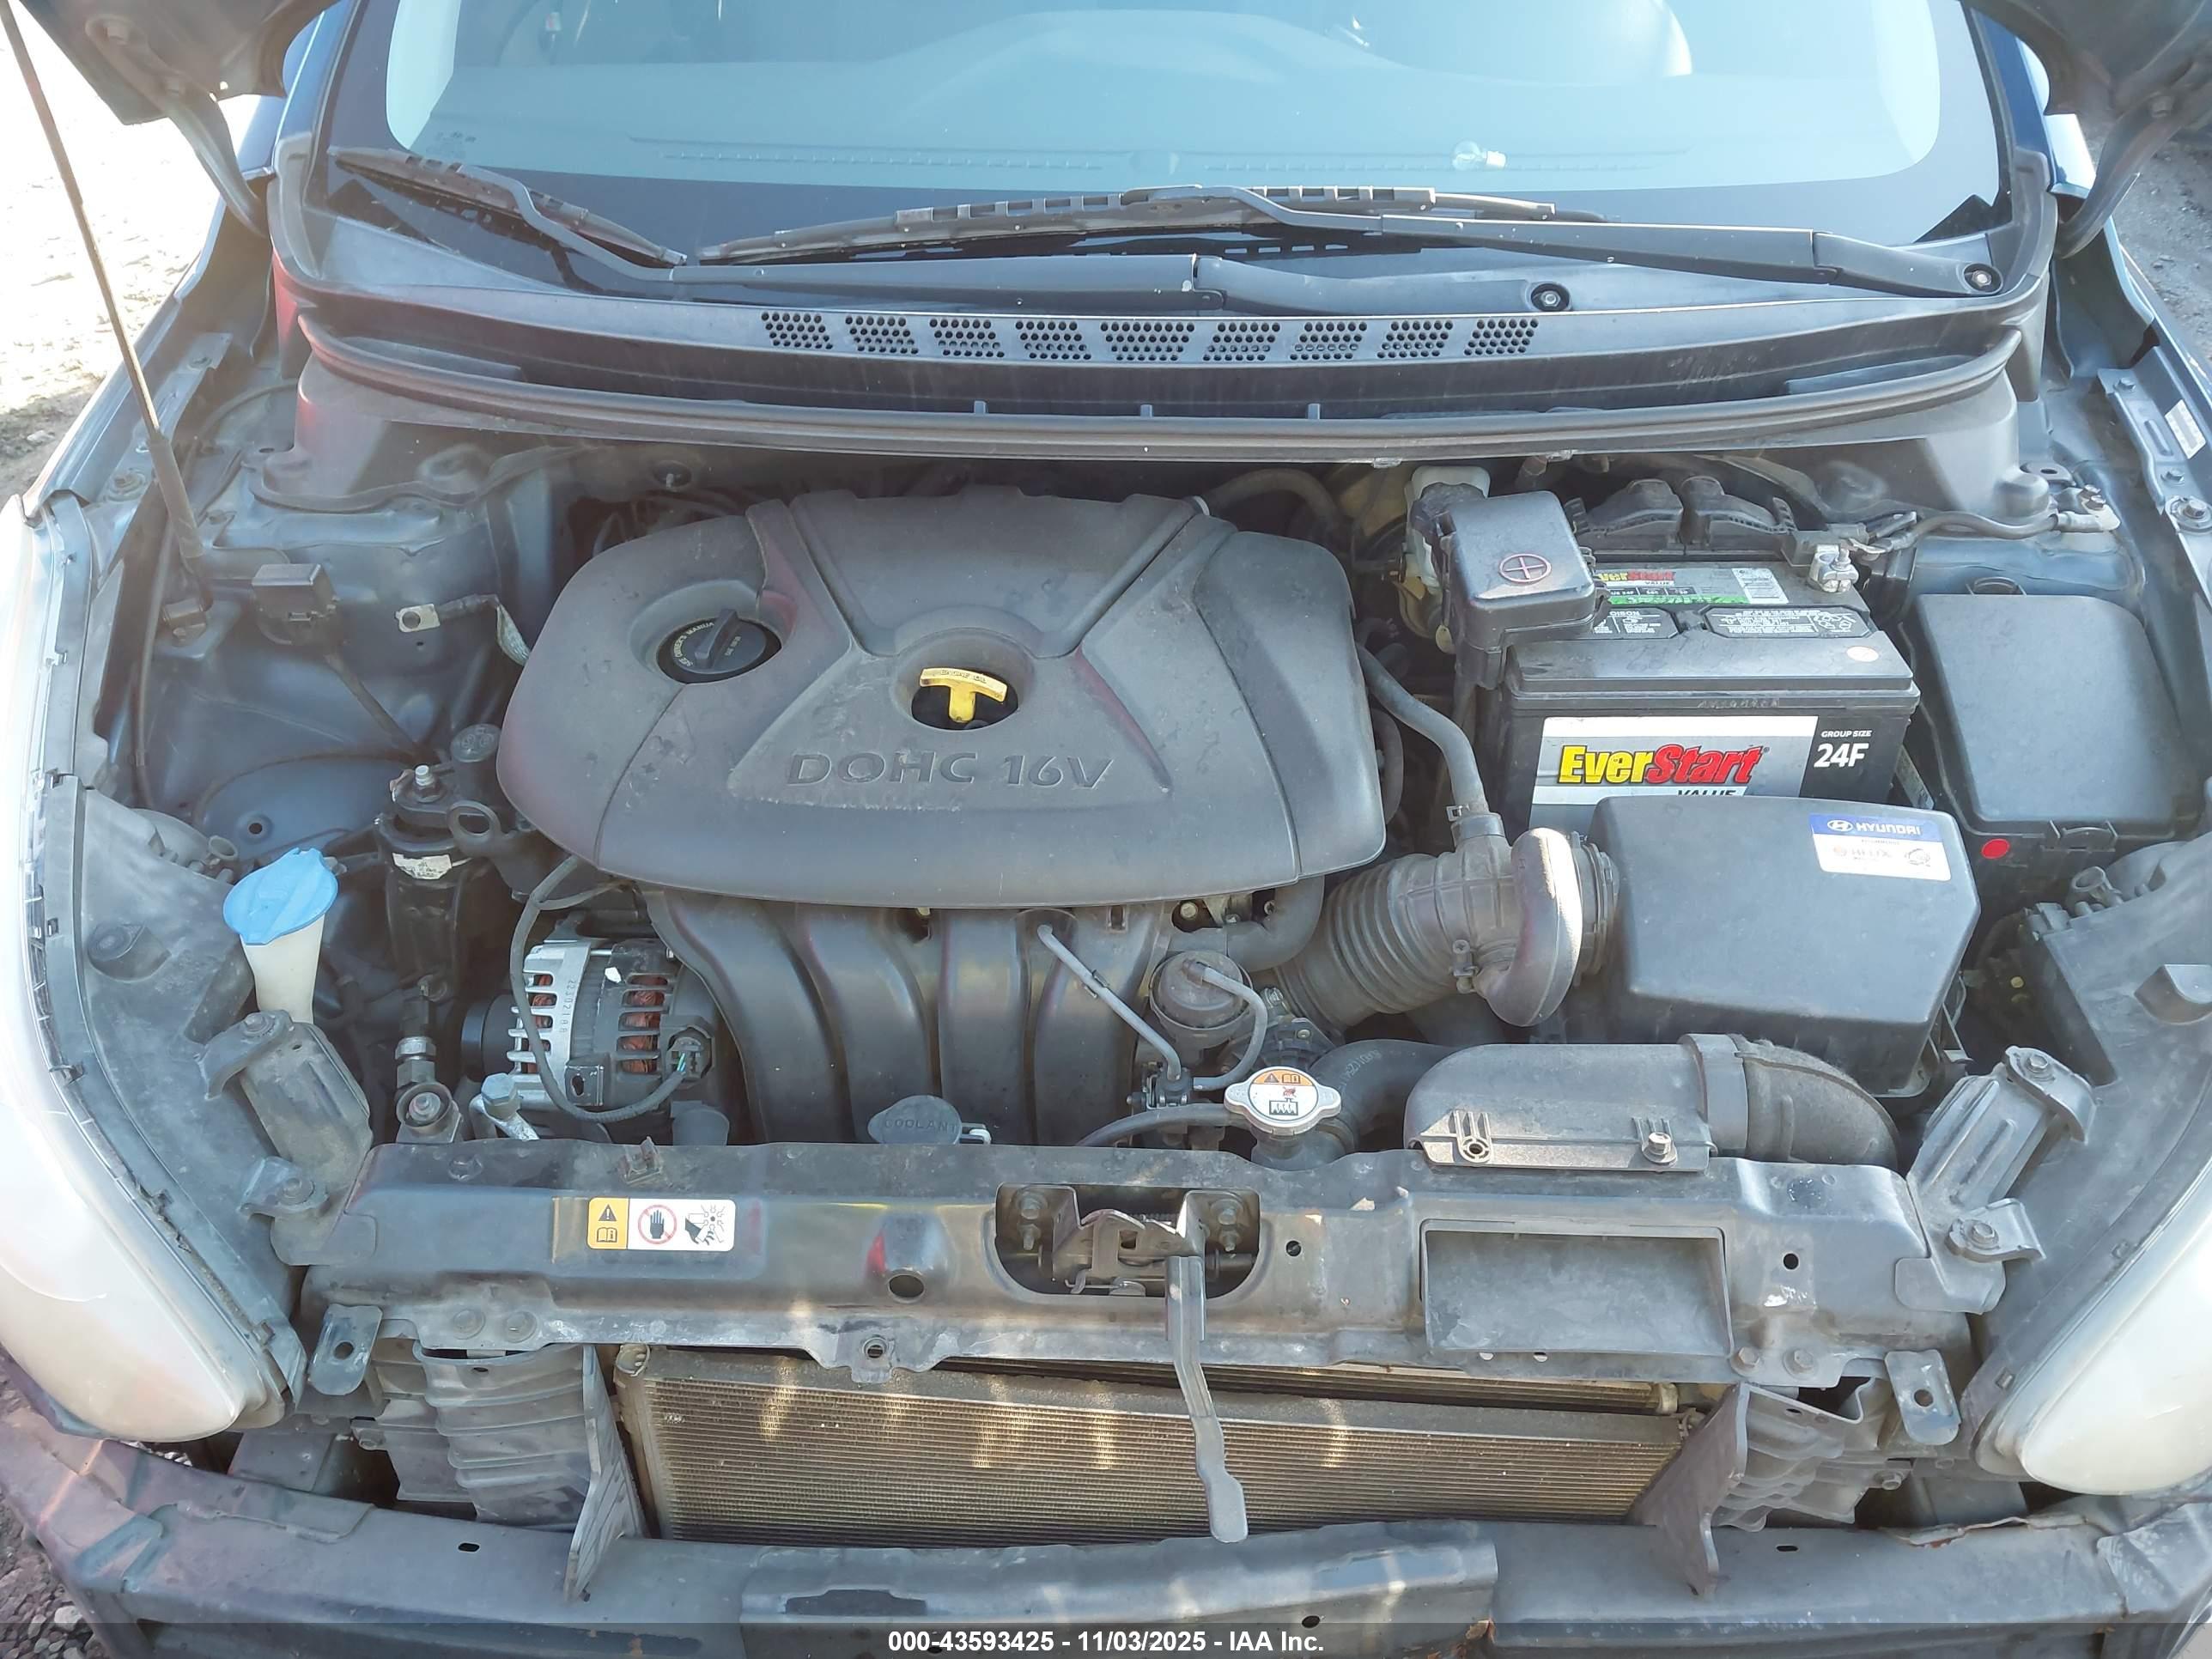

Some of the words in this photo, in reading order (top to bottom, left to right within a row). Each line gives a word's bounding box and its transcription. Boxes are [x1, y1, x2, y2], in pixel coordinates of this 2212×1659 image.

[1821, 730, 1850, 738] GROUP
[1852, 729, 1873, 738] SIZE
[1558, 744, 1764, 785] EverStart
[1814, 743, 1870, 769] 24F
[787, 751, 978, 786] DOHC
[1003, 755, 1115, 790] 16V
[1855, 822, 1921, 836] HYUNDAI
[884, 1118, 957, 1133] COOLANT
